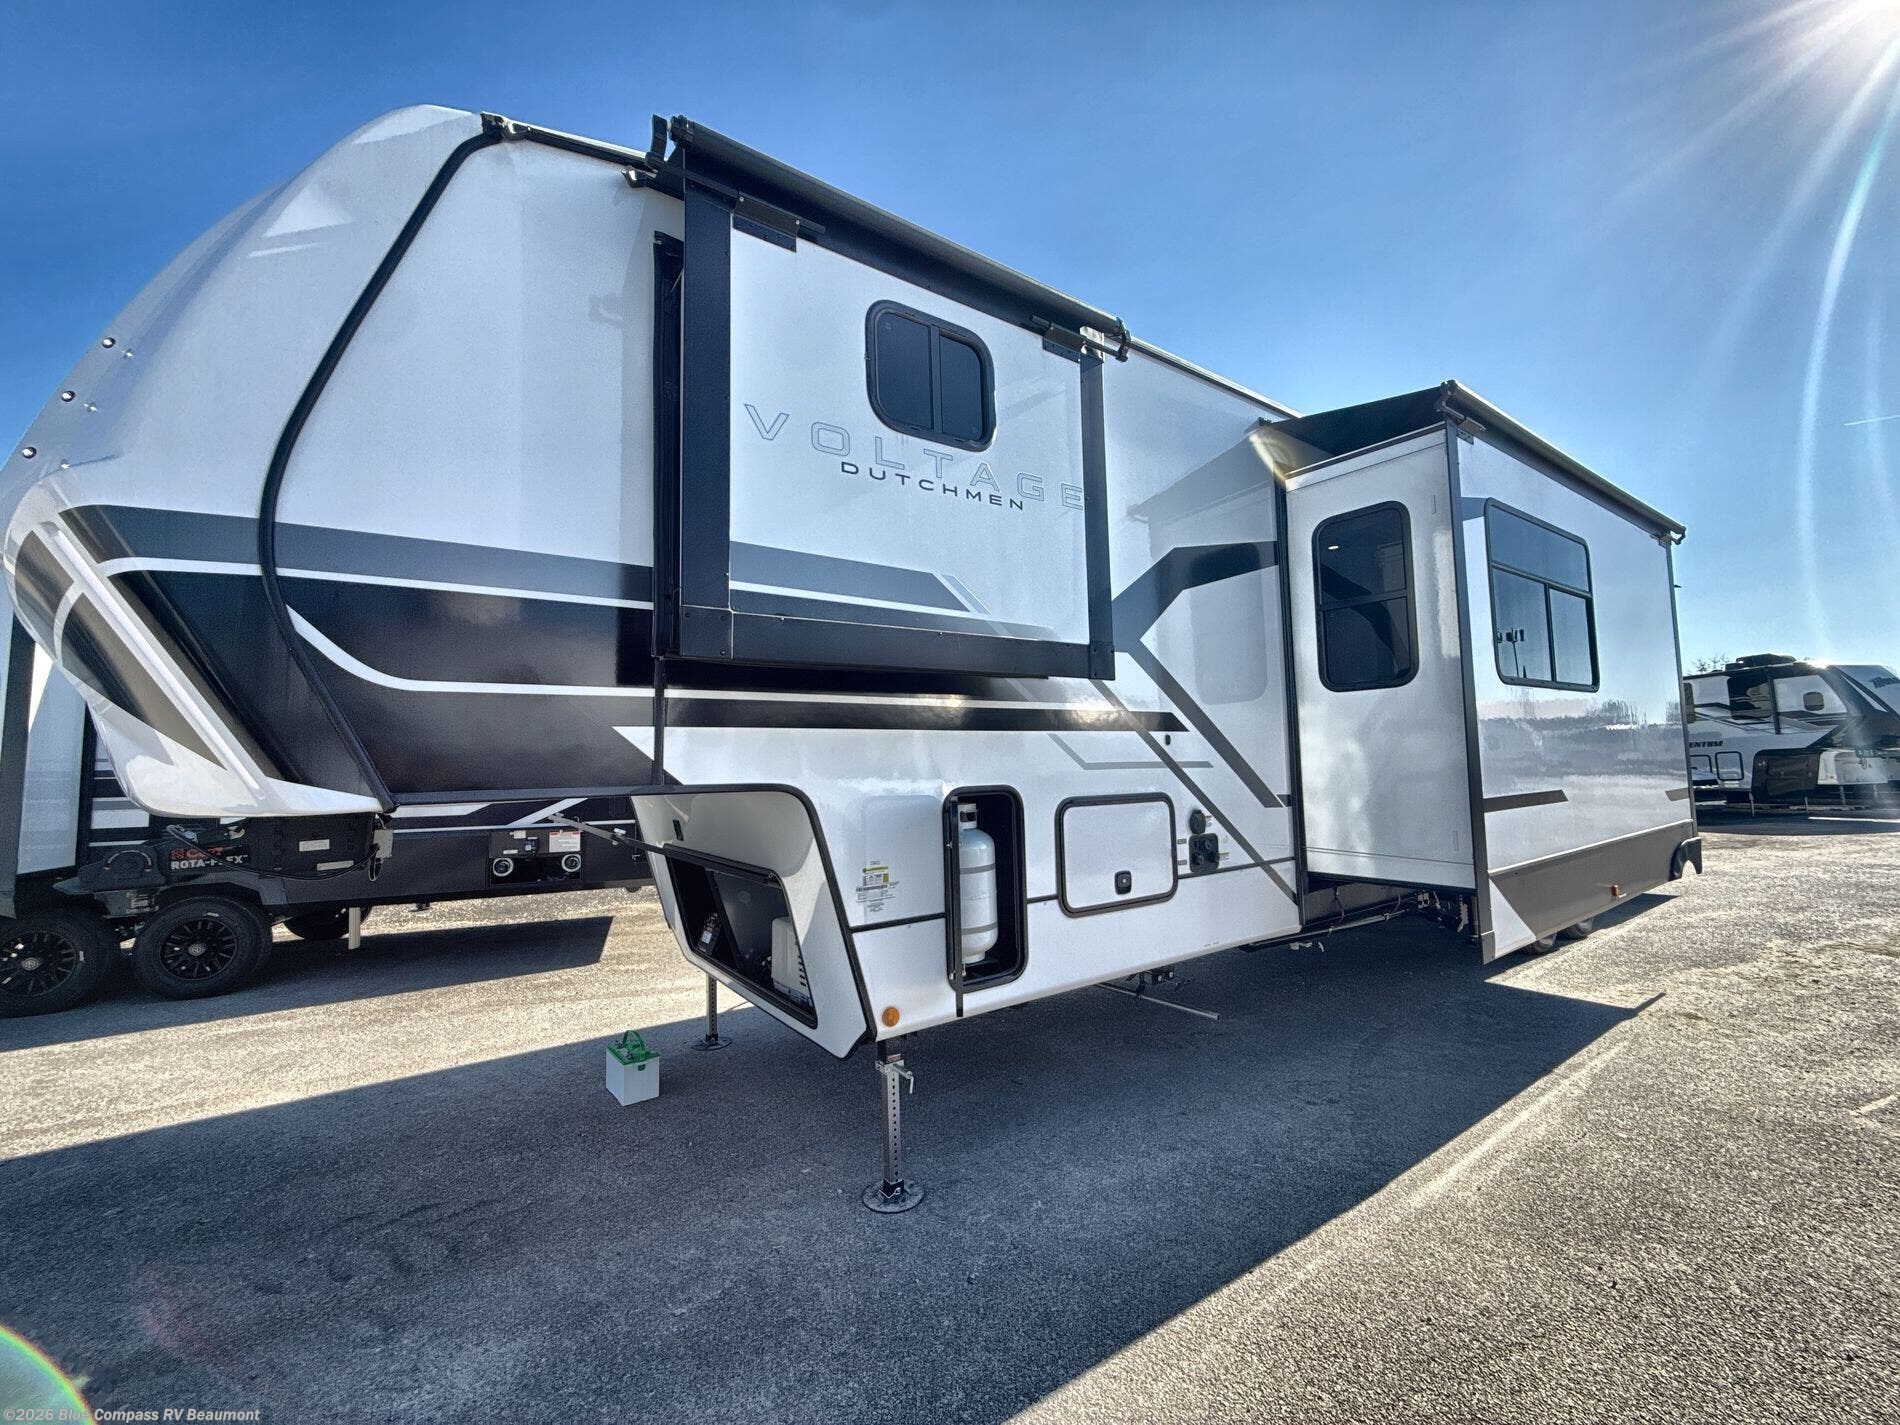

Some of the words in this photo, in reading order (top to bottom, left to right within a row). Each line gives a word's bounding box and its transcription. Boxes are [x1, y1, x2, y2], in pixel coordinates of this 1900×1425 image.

[744, 403, 1084, 510] VOLTAGE
[841, 461, 1023, 510] DUTCHMEN
[170, 855, 243, 870] ROTA-FEX
